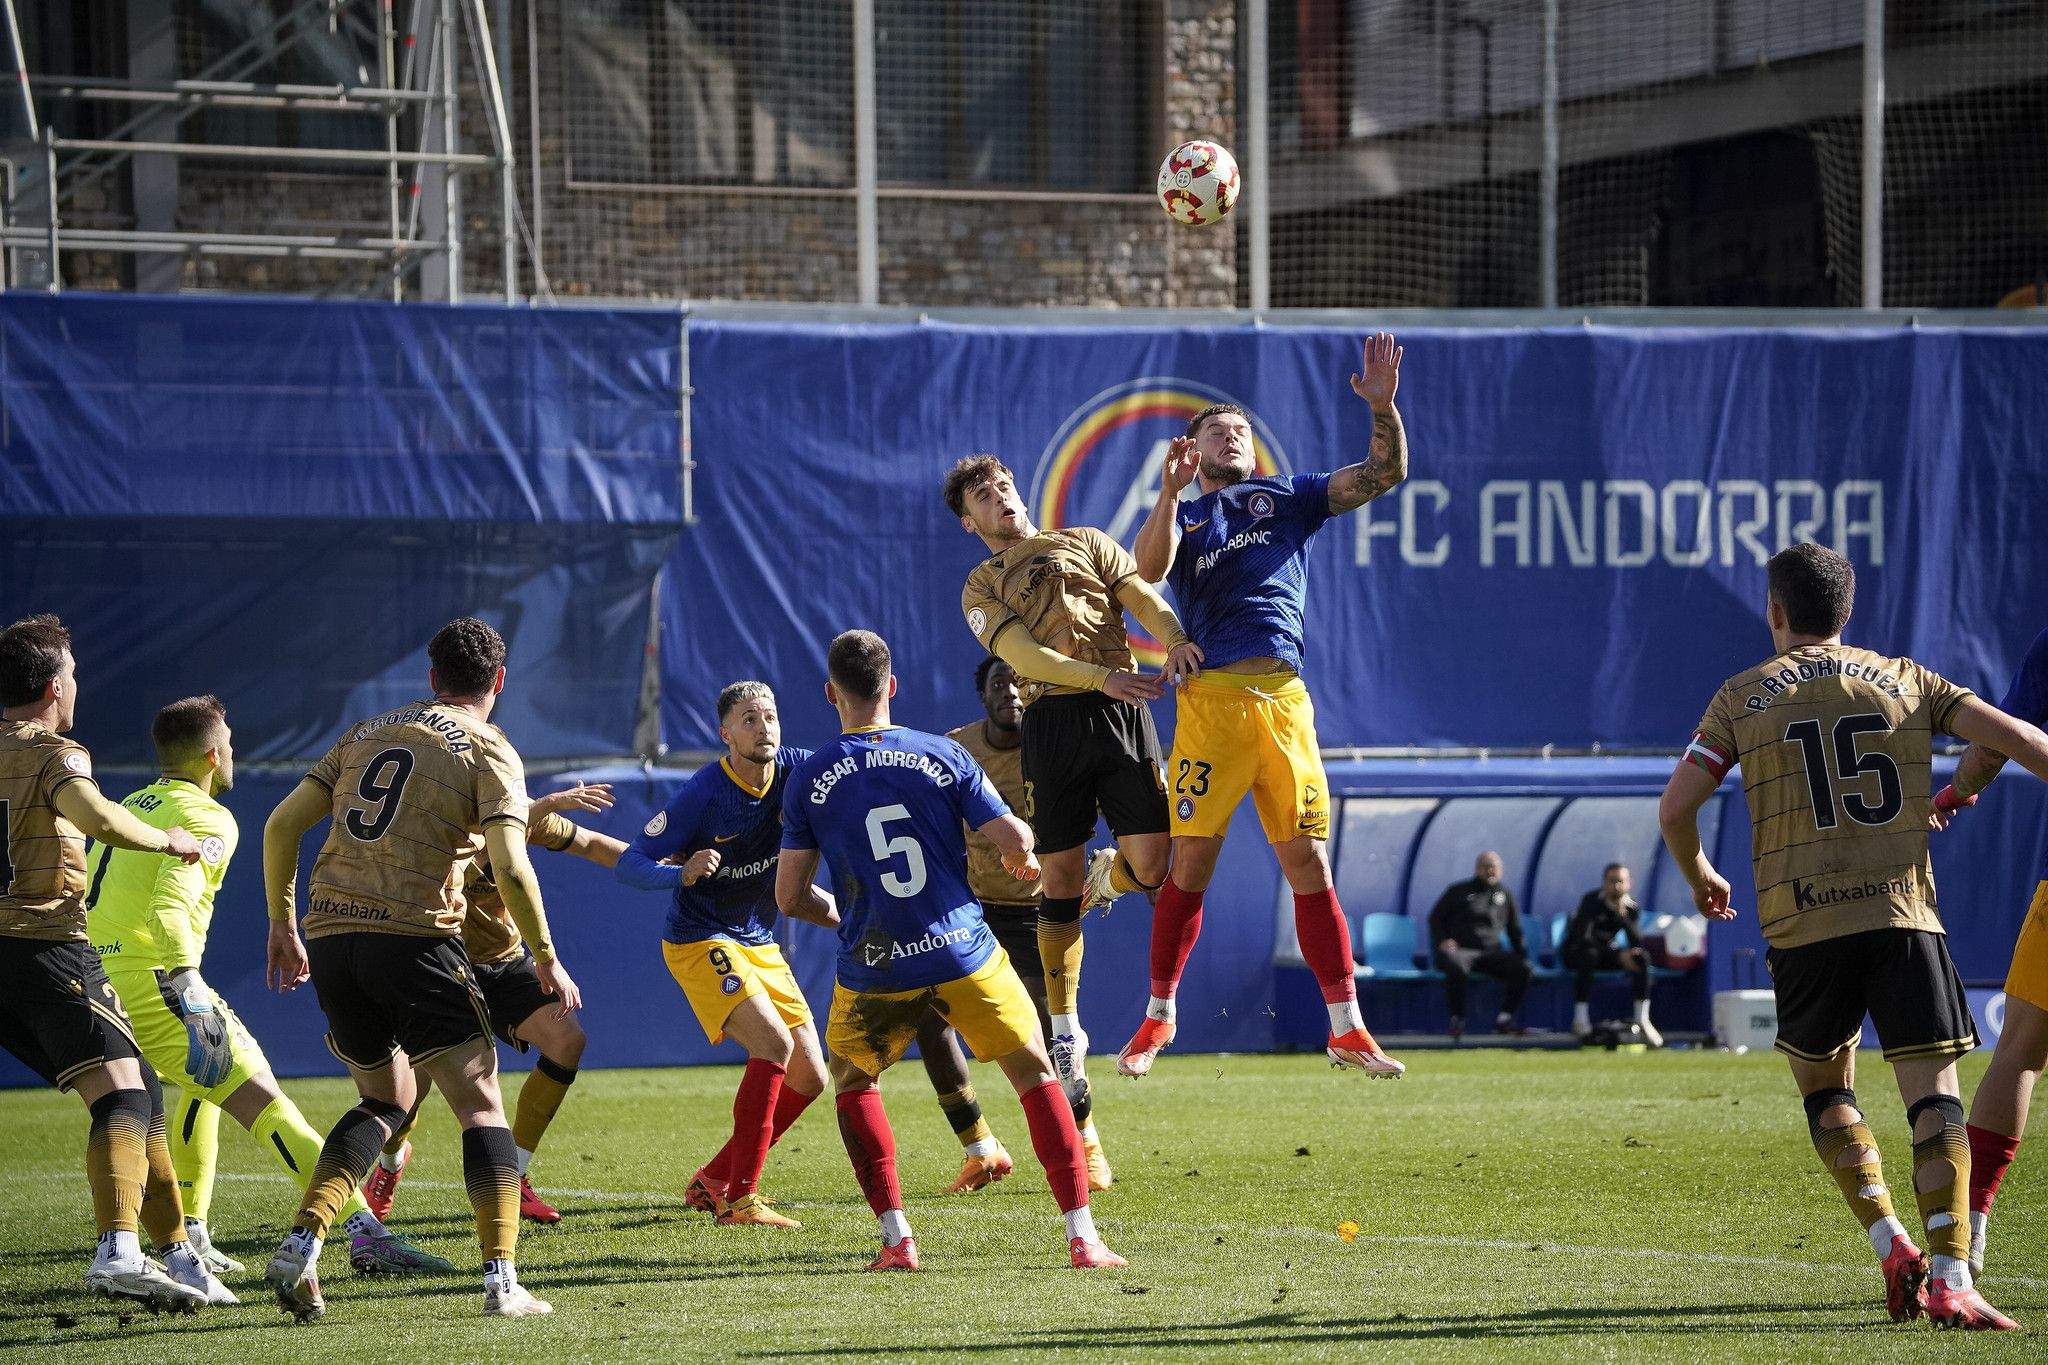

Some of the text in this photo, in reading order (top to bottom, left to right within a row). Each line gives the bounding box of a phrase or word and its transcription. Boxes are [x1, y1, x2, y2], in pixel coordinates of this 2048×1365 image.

[1355, 480, 1884, 567] FC ANDORRA
[1205, 530, 1272, 570] MABANC
[344, 747, 416, 842] 9
[810, 750, 954, 805] CÉSAR MORGADO
[1175, 758, 1213, 797] 23
[1783, 712, 1904, 831] 15
[864, 803, 928, 898] 5
[1792, 877, 1915, 911] Kutxabank
[708, 946, 733, 976] 9
[889, 926, 973, 961] Andorra
